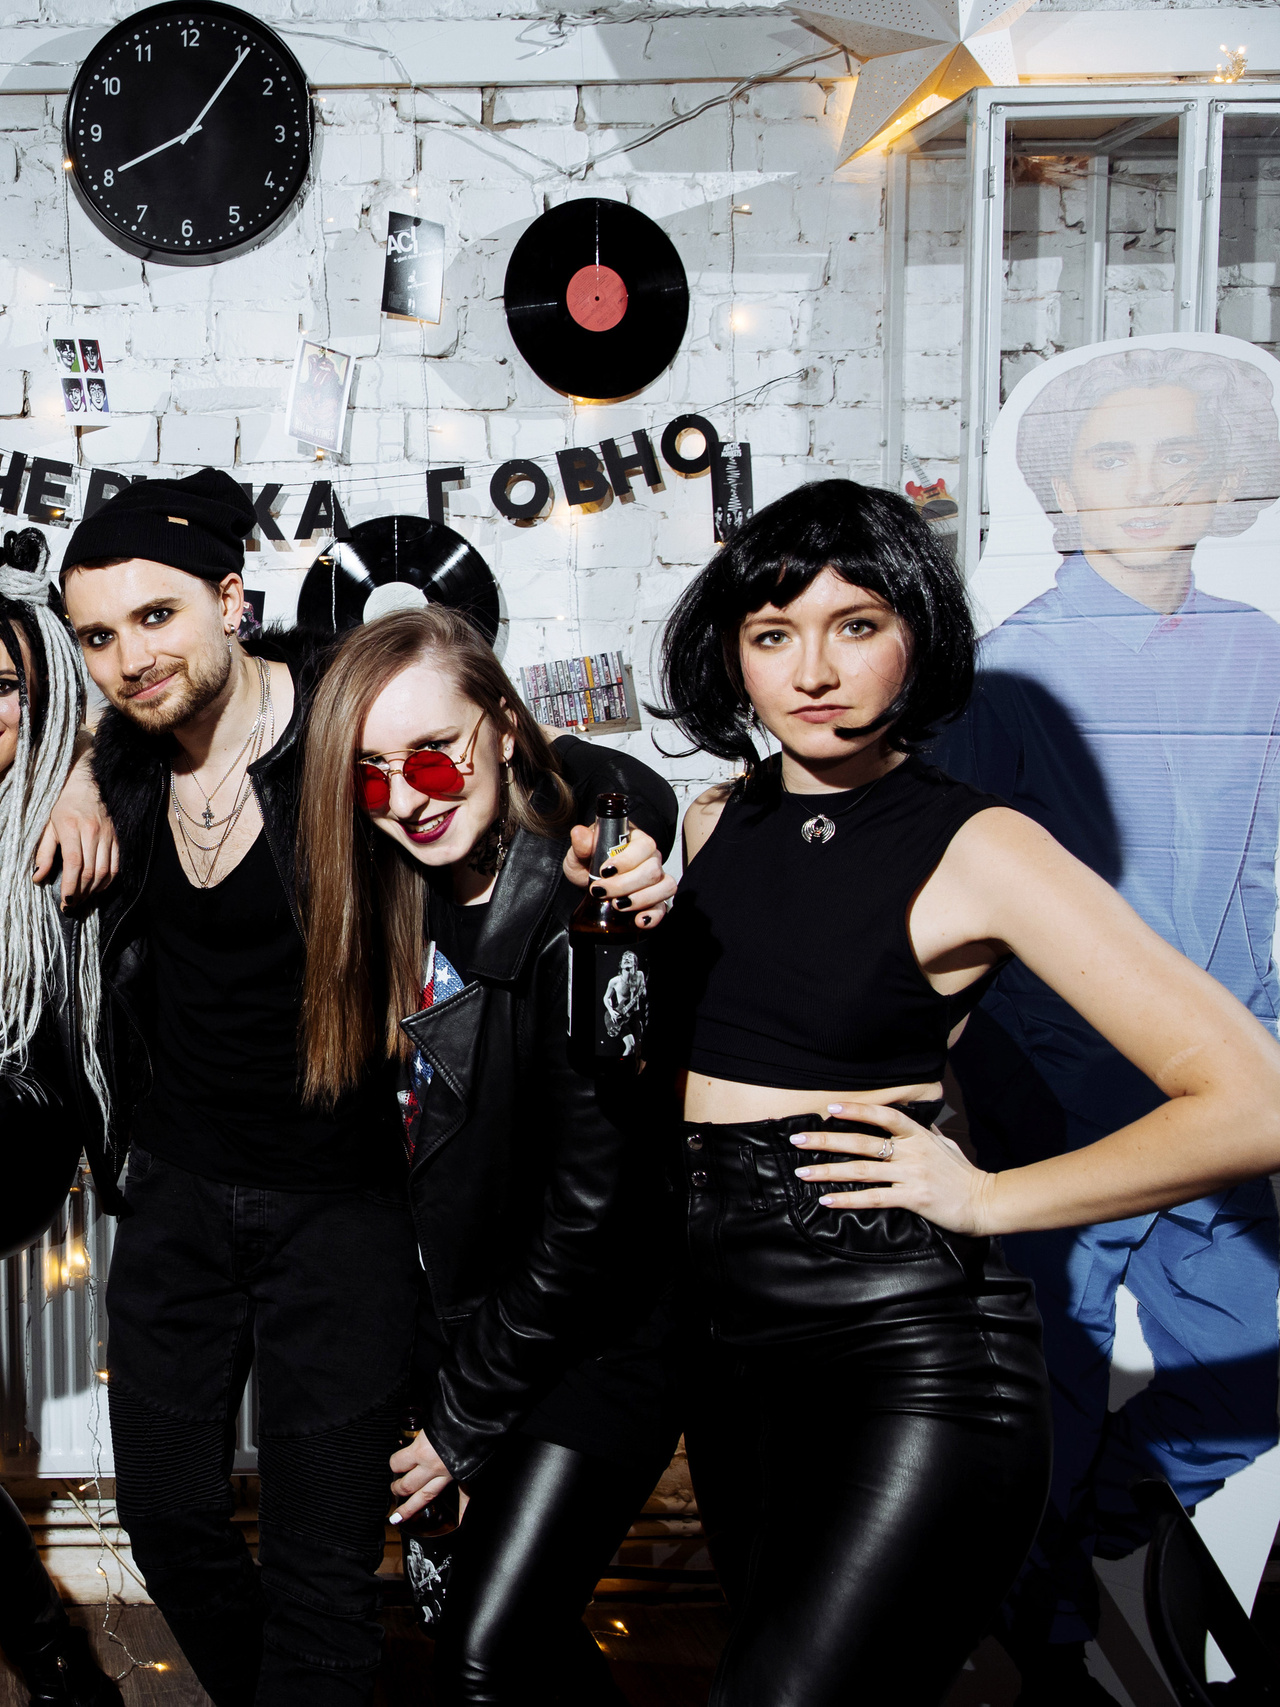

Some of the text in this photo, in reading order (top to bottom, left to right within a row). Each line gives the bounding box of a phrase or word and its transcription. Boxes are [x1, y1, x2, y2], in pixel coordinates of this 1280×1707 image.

[180, 28, 200, 47] 12
[134, 44, 152, 62] 11
[234, 45, 244, 60] 1
[102, 76, 121, 96] 10
[262, 78, 273, 96] 2
[90, 124, 102, 142] 9
[274, 125, 286, 143] 3
[103, 169, 114, 187] 8
[264, 171, 275, 188] 4
[136, 204, 148, 223] 7
[228, 205, 240, 224] 5
[181, 219, 193, 237] 6
[426, 414, 719, 525] ГОВНО
